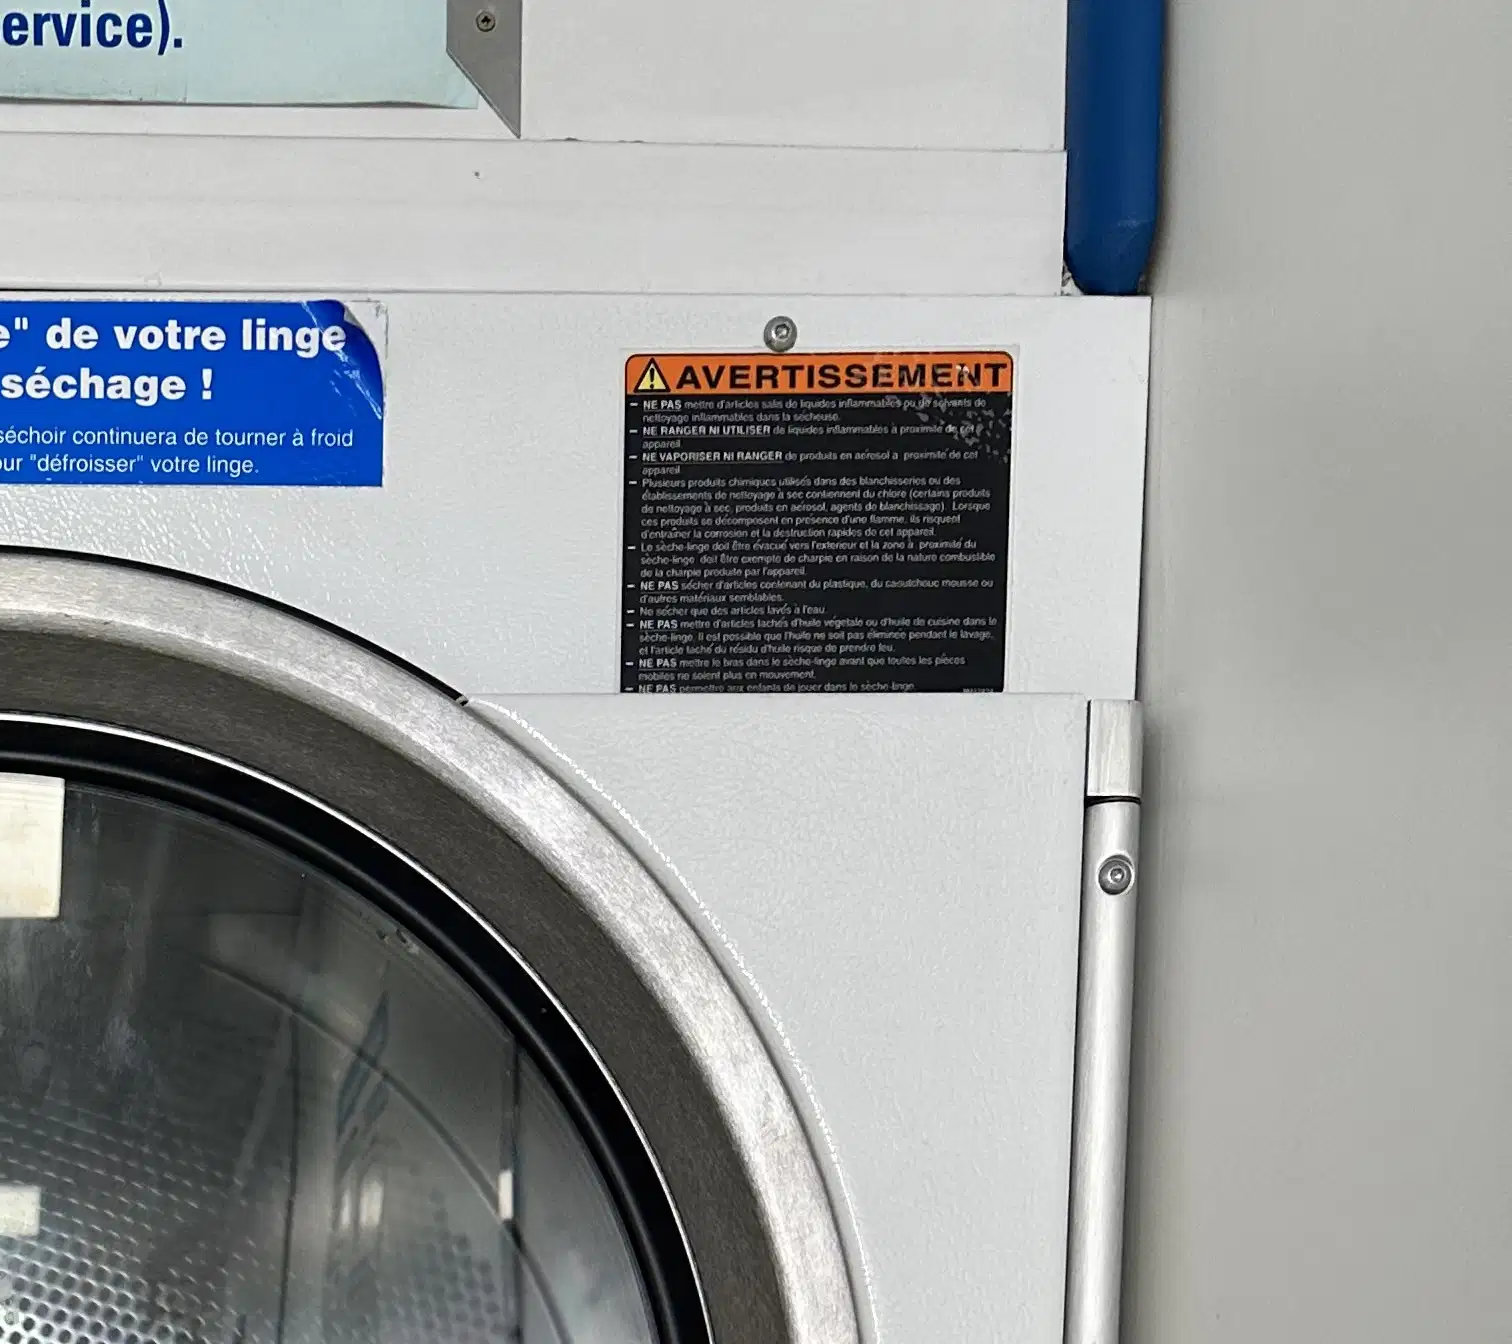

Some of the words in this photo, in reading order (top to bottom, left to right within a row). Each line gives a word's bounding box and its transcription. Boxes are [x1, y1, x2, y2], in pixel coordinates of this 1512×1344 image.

[46, 317, 98, 350] de
[113, 319, 226, 351] votre
[242, 318, 347, 358] linge
[676, 363, 1007, 389] AVERTISSEMENT
[0, 366, 186, 406] séchage
[201, 368, 213, 400] !
[643, 400, 657, 409] NE
[660, 400, 682, 409] PAS
[643, 425, 657, 435] NE
[660, 425, 706, 435] RANGER
[709, 425, 720, 435] NI
[722, 425, 771, 435] UTILISER
[72, 427, 177, 446] continuera
[184, 427, 208, 446] de
[215, 428, 286, 447] tourner
[292, 428, 304, 447] à
[311, 428, 354, 447] froid
[642, 451, 656, 461] NE
[659, 451, 721, 461] VAPORISER
[723, 451, 734, 460] NI
[737, 450, 782, 460] RANGER
[30, 453, 143, 473] "défroisser"
[151, 457, 200, 473] votre
[207, 456, 259, 478] linge.
[640, 580, 654, 590] NE
[658, 580, 679, 590] PAS
[639, 619, 654, 628] NE
[657, 618, 678, 628] PAS
[639, 657, 653, 667] NE
[656, 657, 677, 667] PAS
